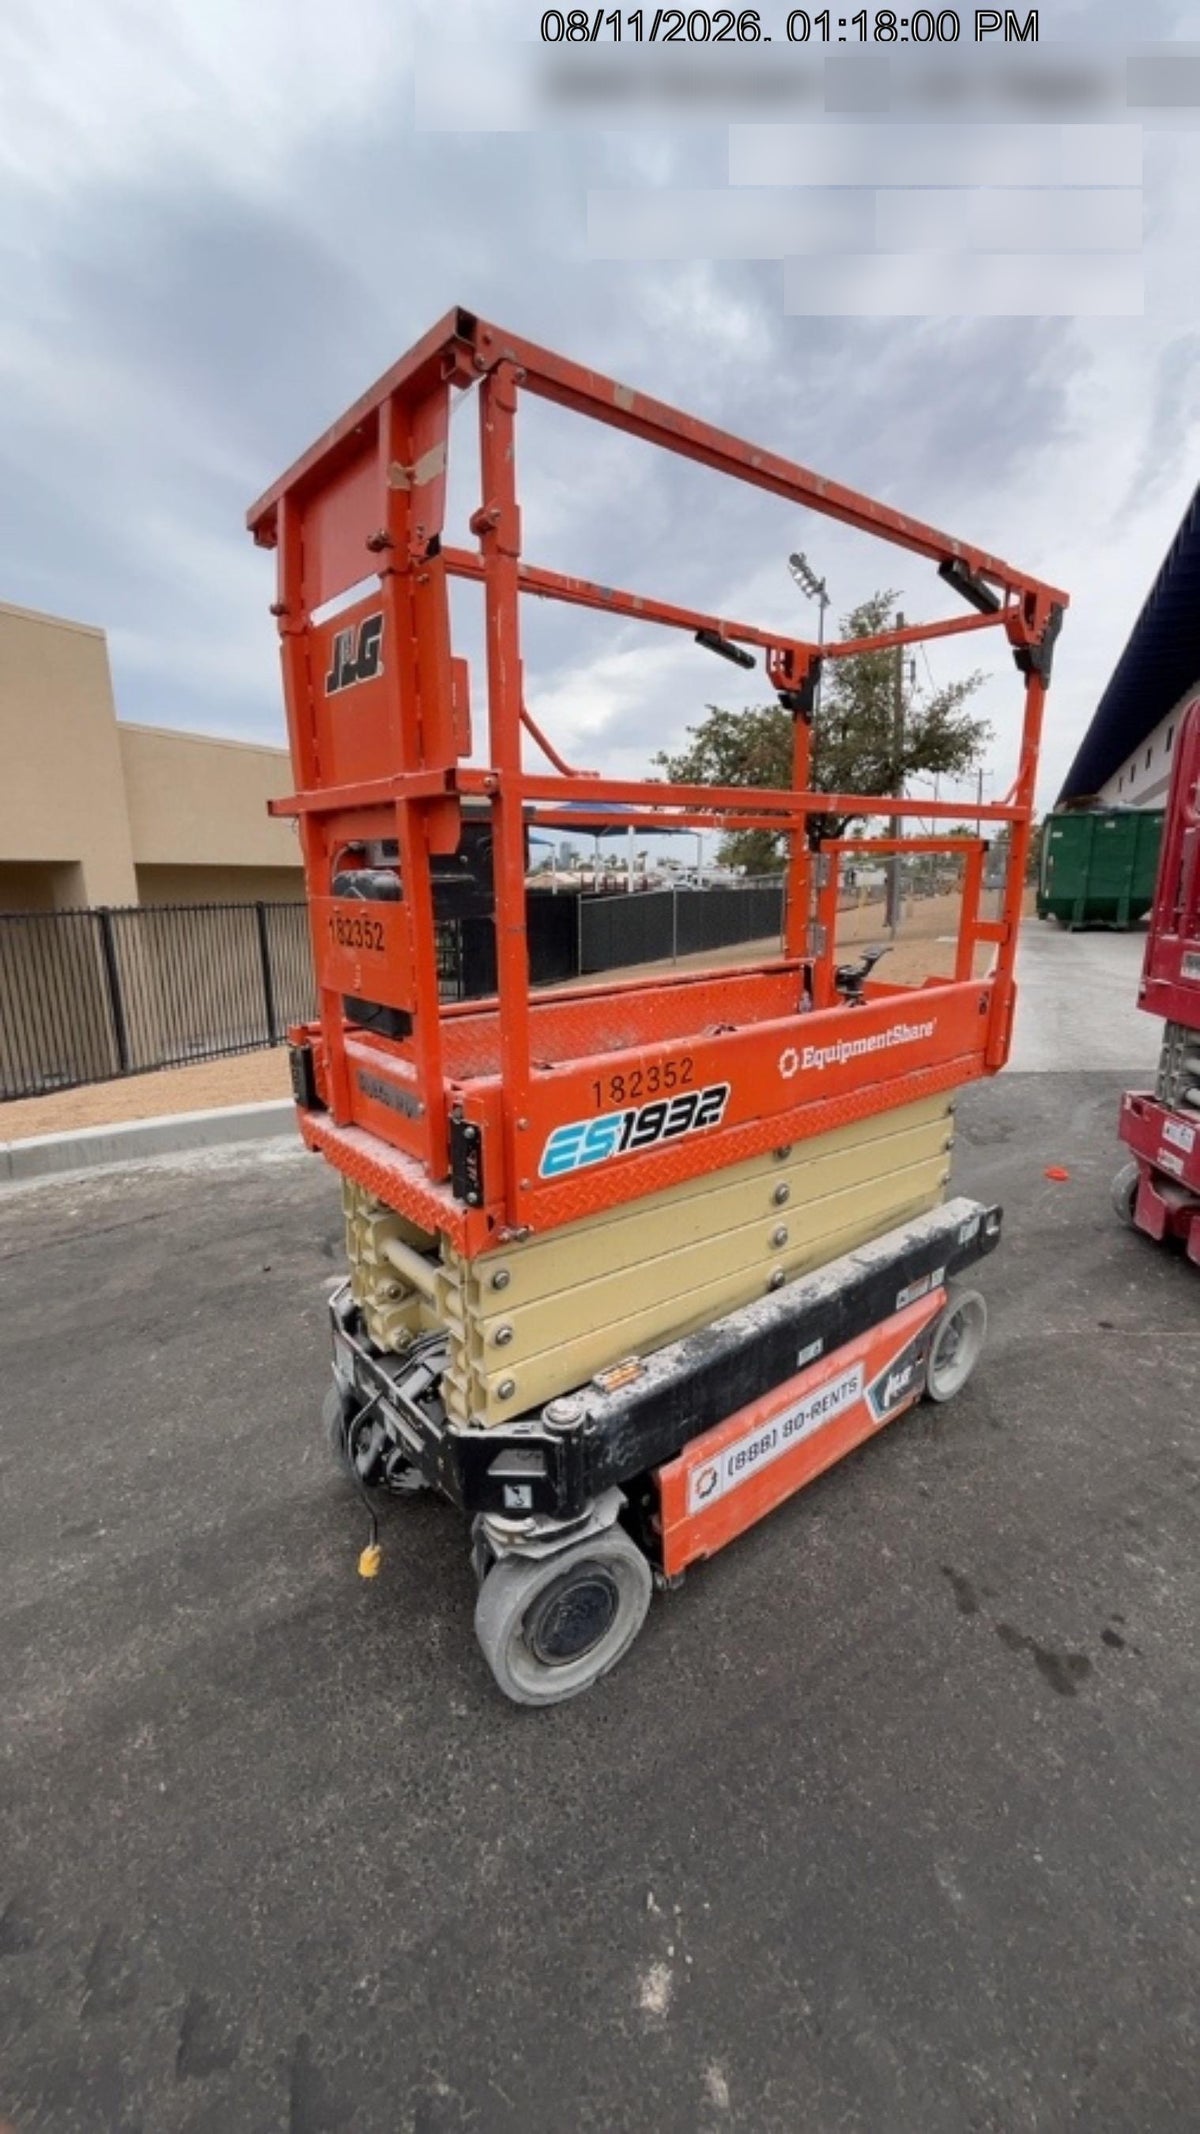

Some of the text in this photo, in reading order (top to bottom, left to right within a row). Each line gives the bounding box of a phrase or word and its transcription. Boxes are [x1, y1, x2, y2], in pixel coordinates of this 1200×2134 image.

[325, 611, 384, 697] JLG
[329, 917, 385, 951] 182352
[592, 1057, 693, 1108] 182352
[540, 1083, 730, 1177] ES1932
[727, 1428, 777, 1476] (888)
[782, 1377, 858, 1438] 80-RENTS
